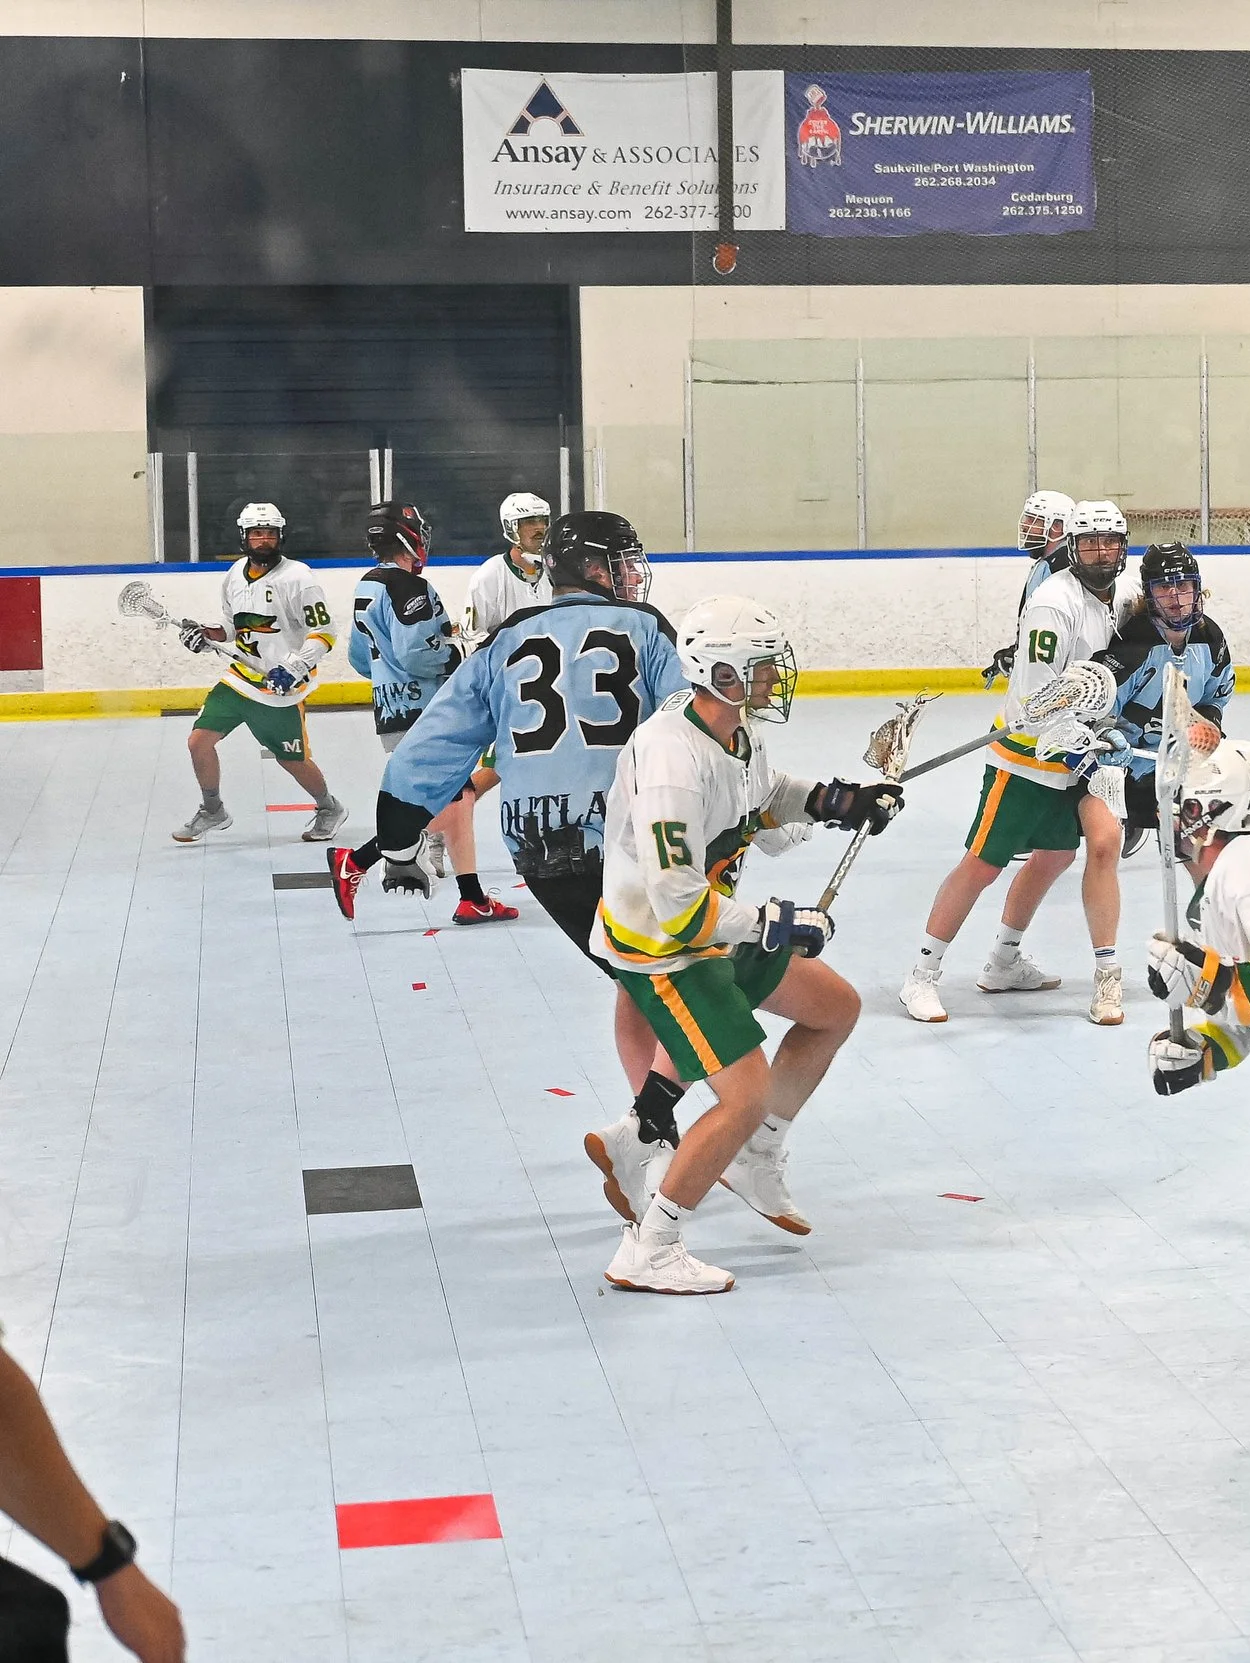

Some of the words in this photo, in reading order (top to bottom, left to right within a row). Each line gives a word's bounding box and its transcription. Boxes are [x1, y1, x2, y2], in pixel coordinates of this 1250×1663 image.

[491, 138, 587, 171] Ansay
[592, 148, 607, 163] &
[612, 145, 760, 163] ASSOCIAES
[963, 162, 1035, 174] Washington
[494, 180, 581, 195] Insurance
[588, 180, 602, 195] &
[608, 180, 672, 195] Benefit
[914, 176, 996, 187] 262.268.2034
[845, 194, 893, 206] Mequon
[1011, 192, 1073, 203] Cedarburg
[505, 207, 632, 223] www.ansay.com
[644, 203, 752, 220] 262-377-200
[1002, 205, 1083, 215] 262.375.1250
[265, 590, 273, 603] C
[1028, 629, 1058, 665] 19
[506, 628, 641, 757] 33
[282, 739, 302, 753] M
[651, 821, 693, 870] 15
